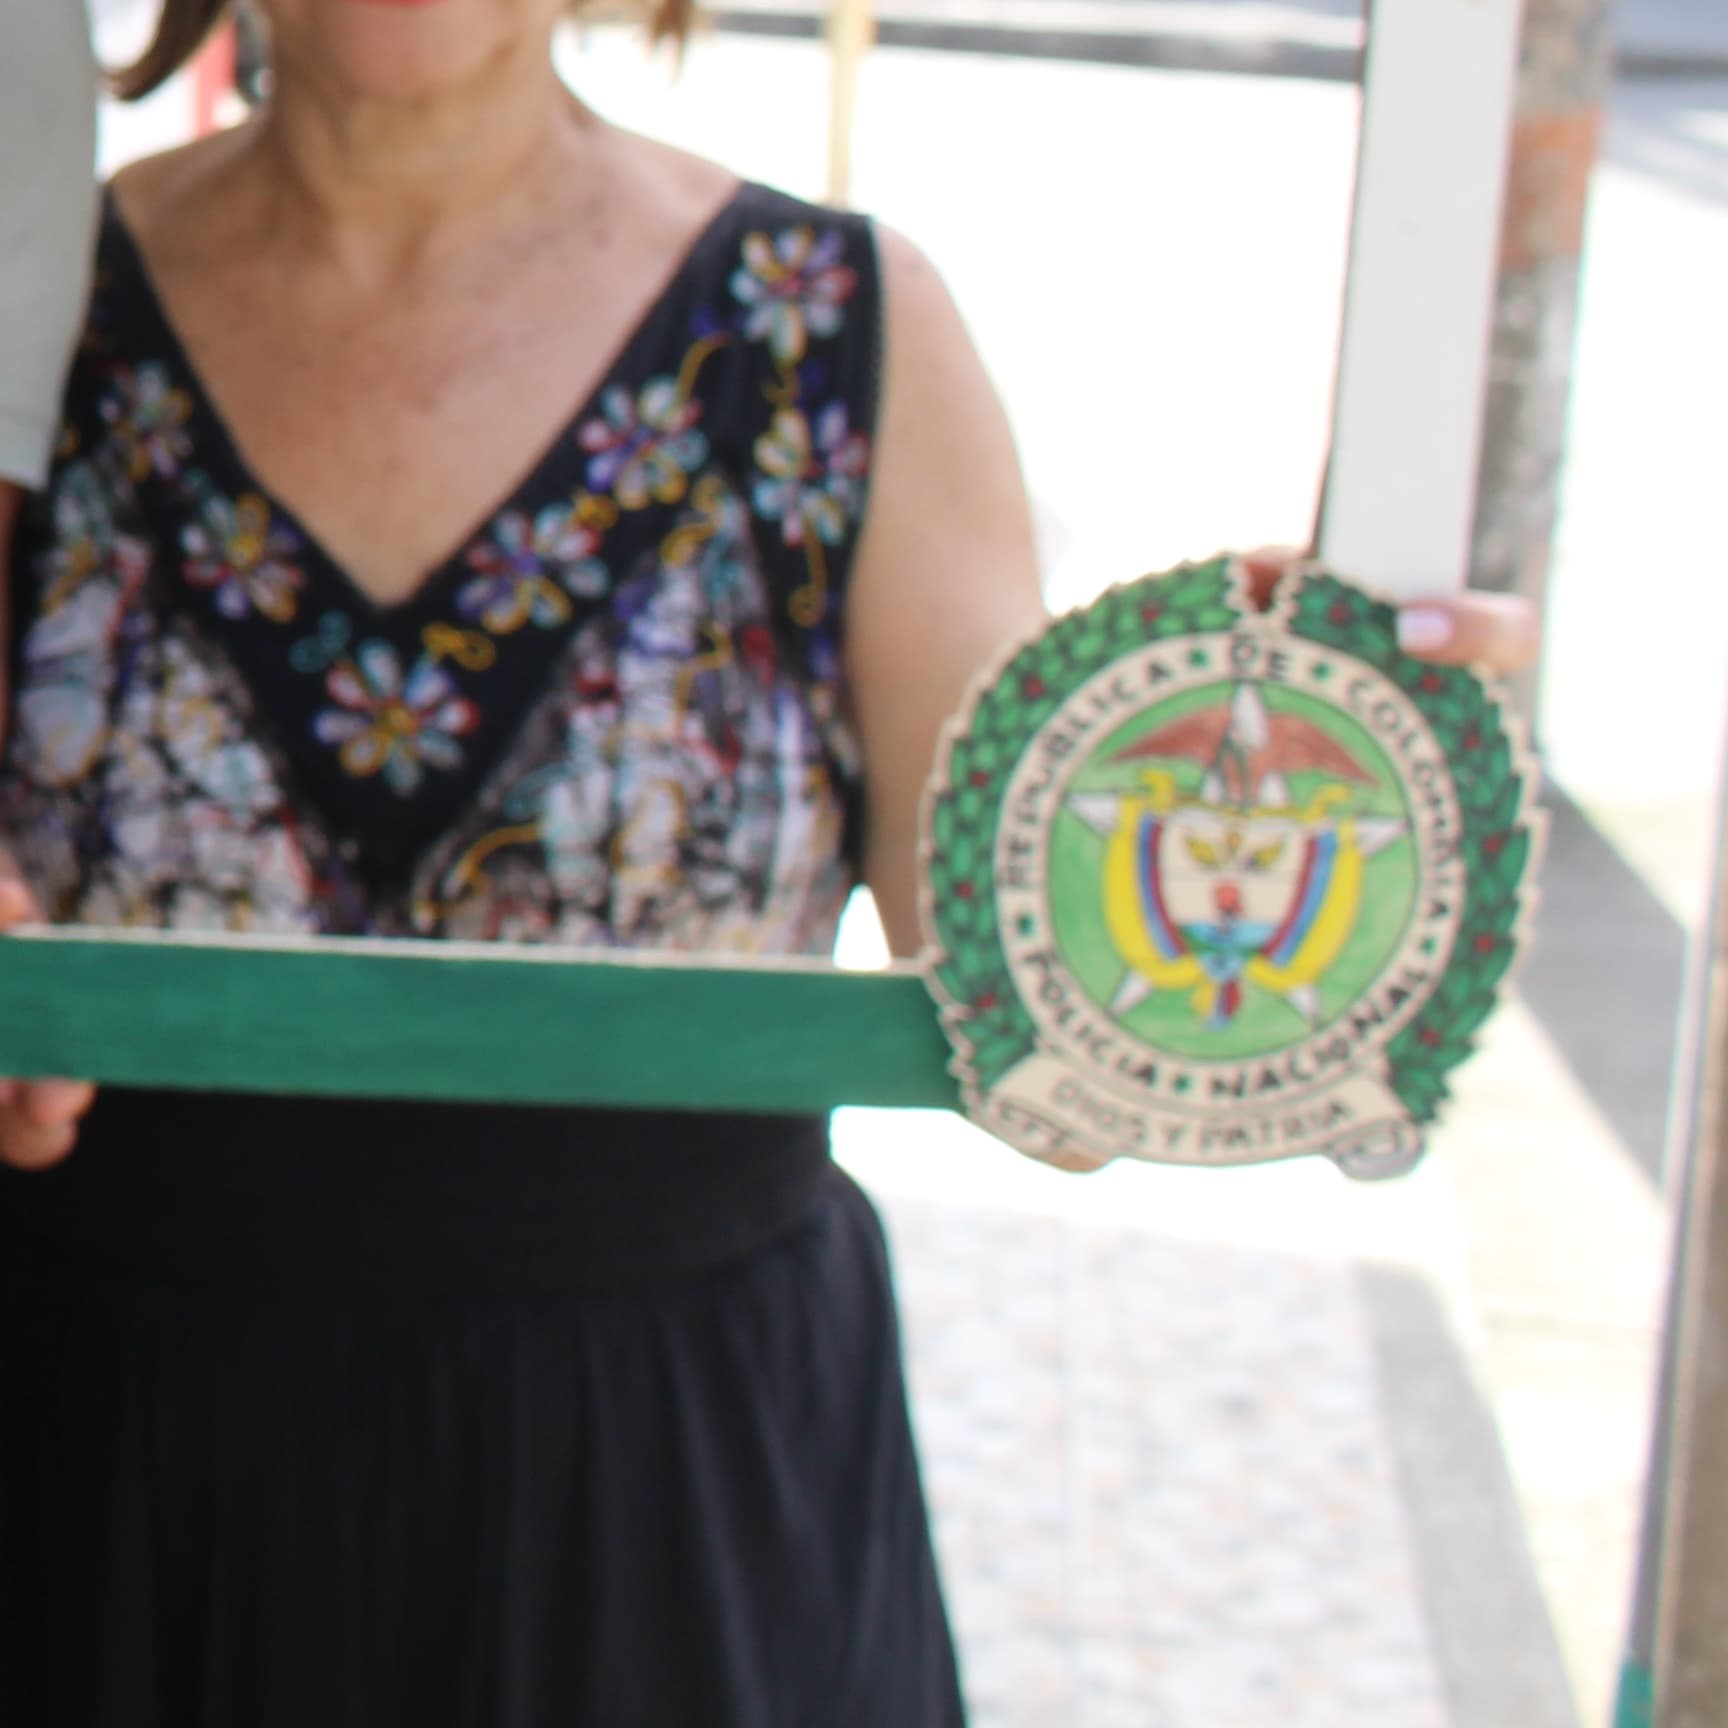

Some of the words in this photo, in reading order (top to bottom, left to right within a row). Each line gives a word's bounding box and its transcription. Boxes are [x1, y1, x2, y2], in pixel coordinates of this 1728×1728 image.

[1229, 634, 1290, 680] DE
[1022, 948, 1159, 1089] POLICIA
[1210, 966, 1431, 1099] NACIONAL
[1198, 1098, 1352, 1149] PATRIA
